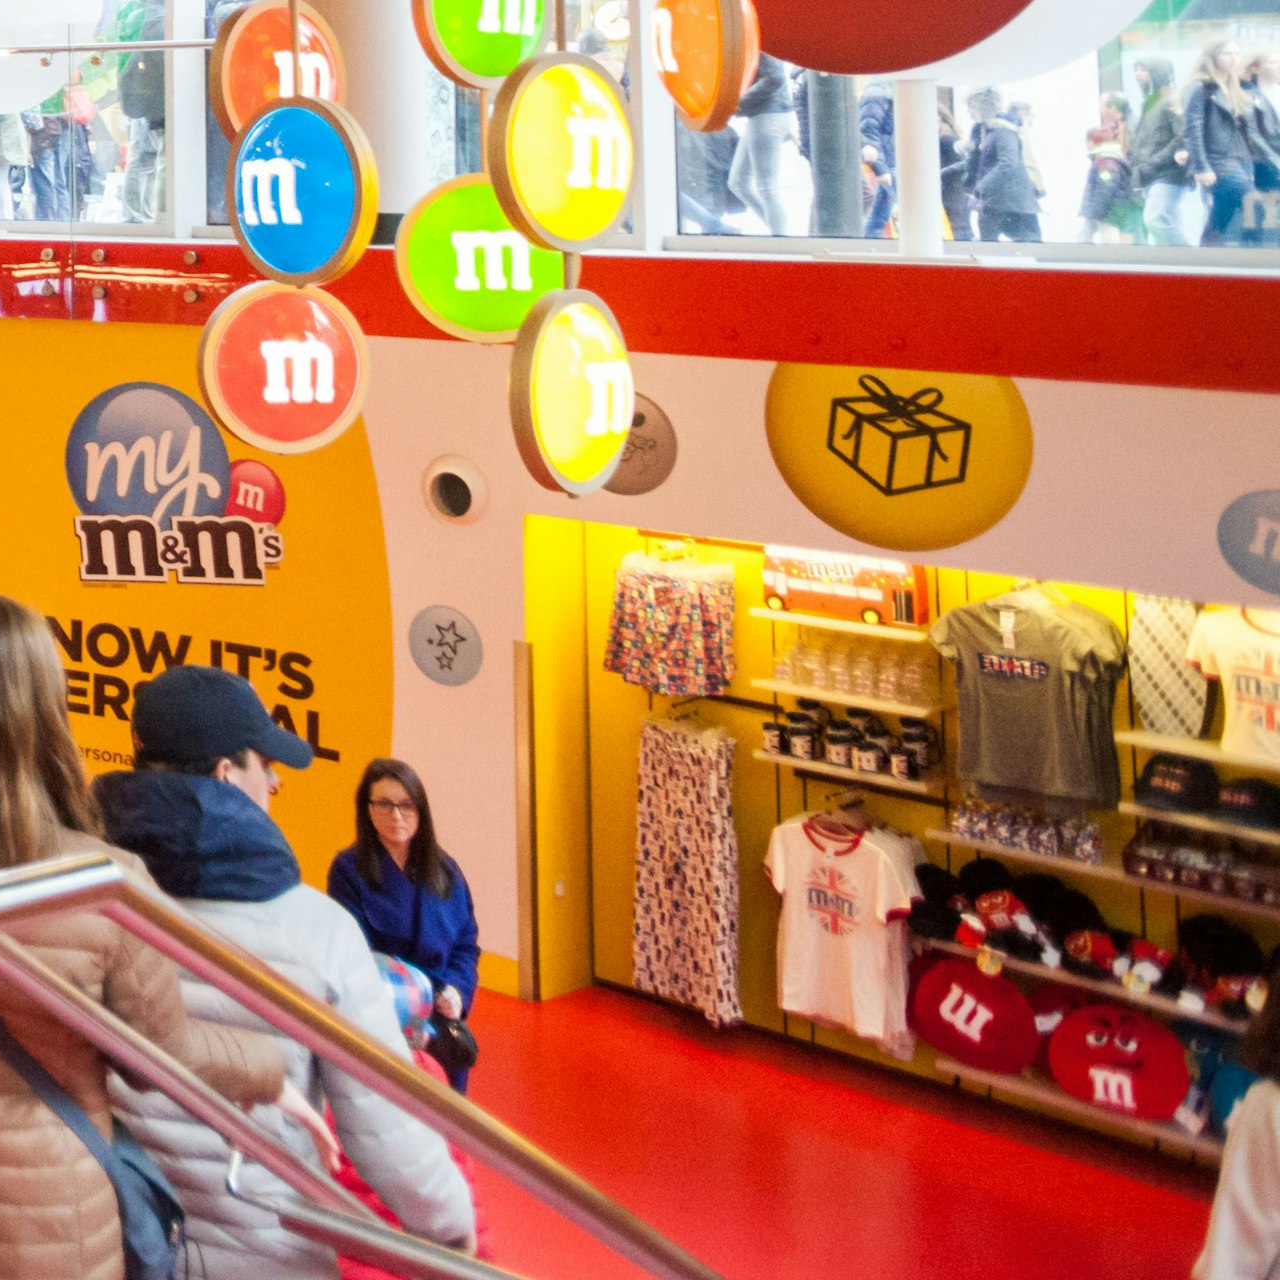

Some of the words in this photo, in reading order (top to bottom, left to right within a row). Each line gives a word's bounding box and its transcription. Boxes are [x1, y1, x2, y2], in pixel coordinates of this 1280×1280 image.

[566, 116, 628, 190] m
[240, 157, 303, 226] m
[451, 231, 532, 291] m
[261, 339, 335, 405] m
[84, 424, 221, 522] my
[235, 480, 265, 513] m
[75, 515, 283, 584] m&m's
[45, 615, 192, 675] NOW
[210, 638, 315, 701] IT'S
[1088, 1066, 1137, 1110] m
